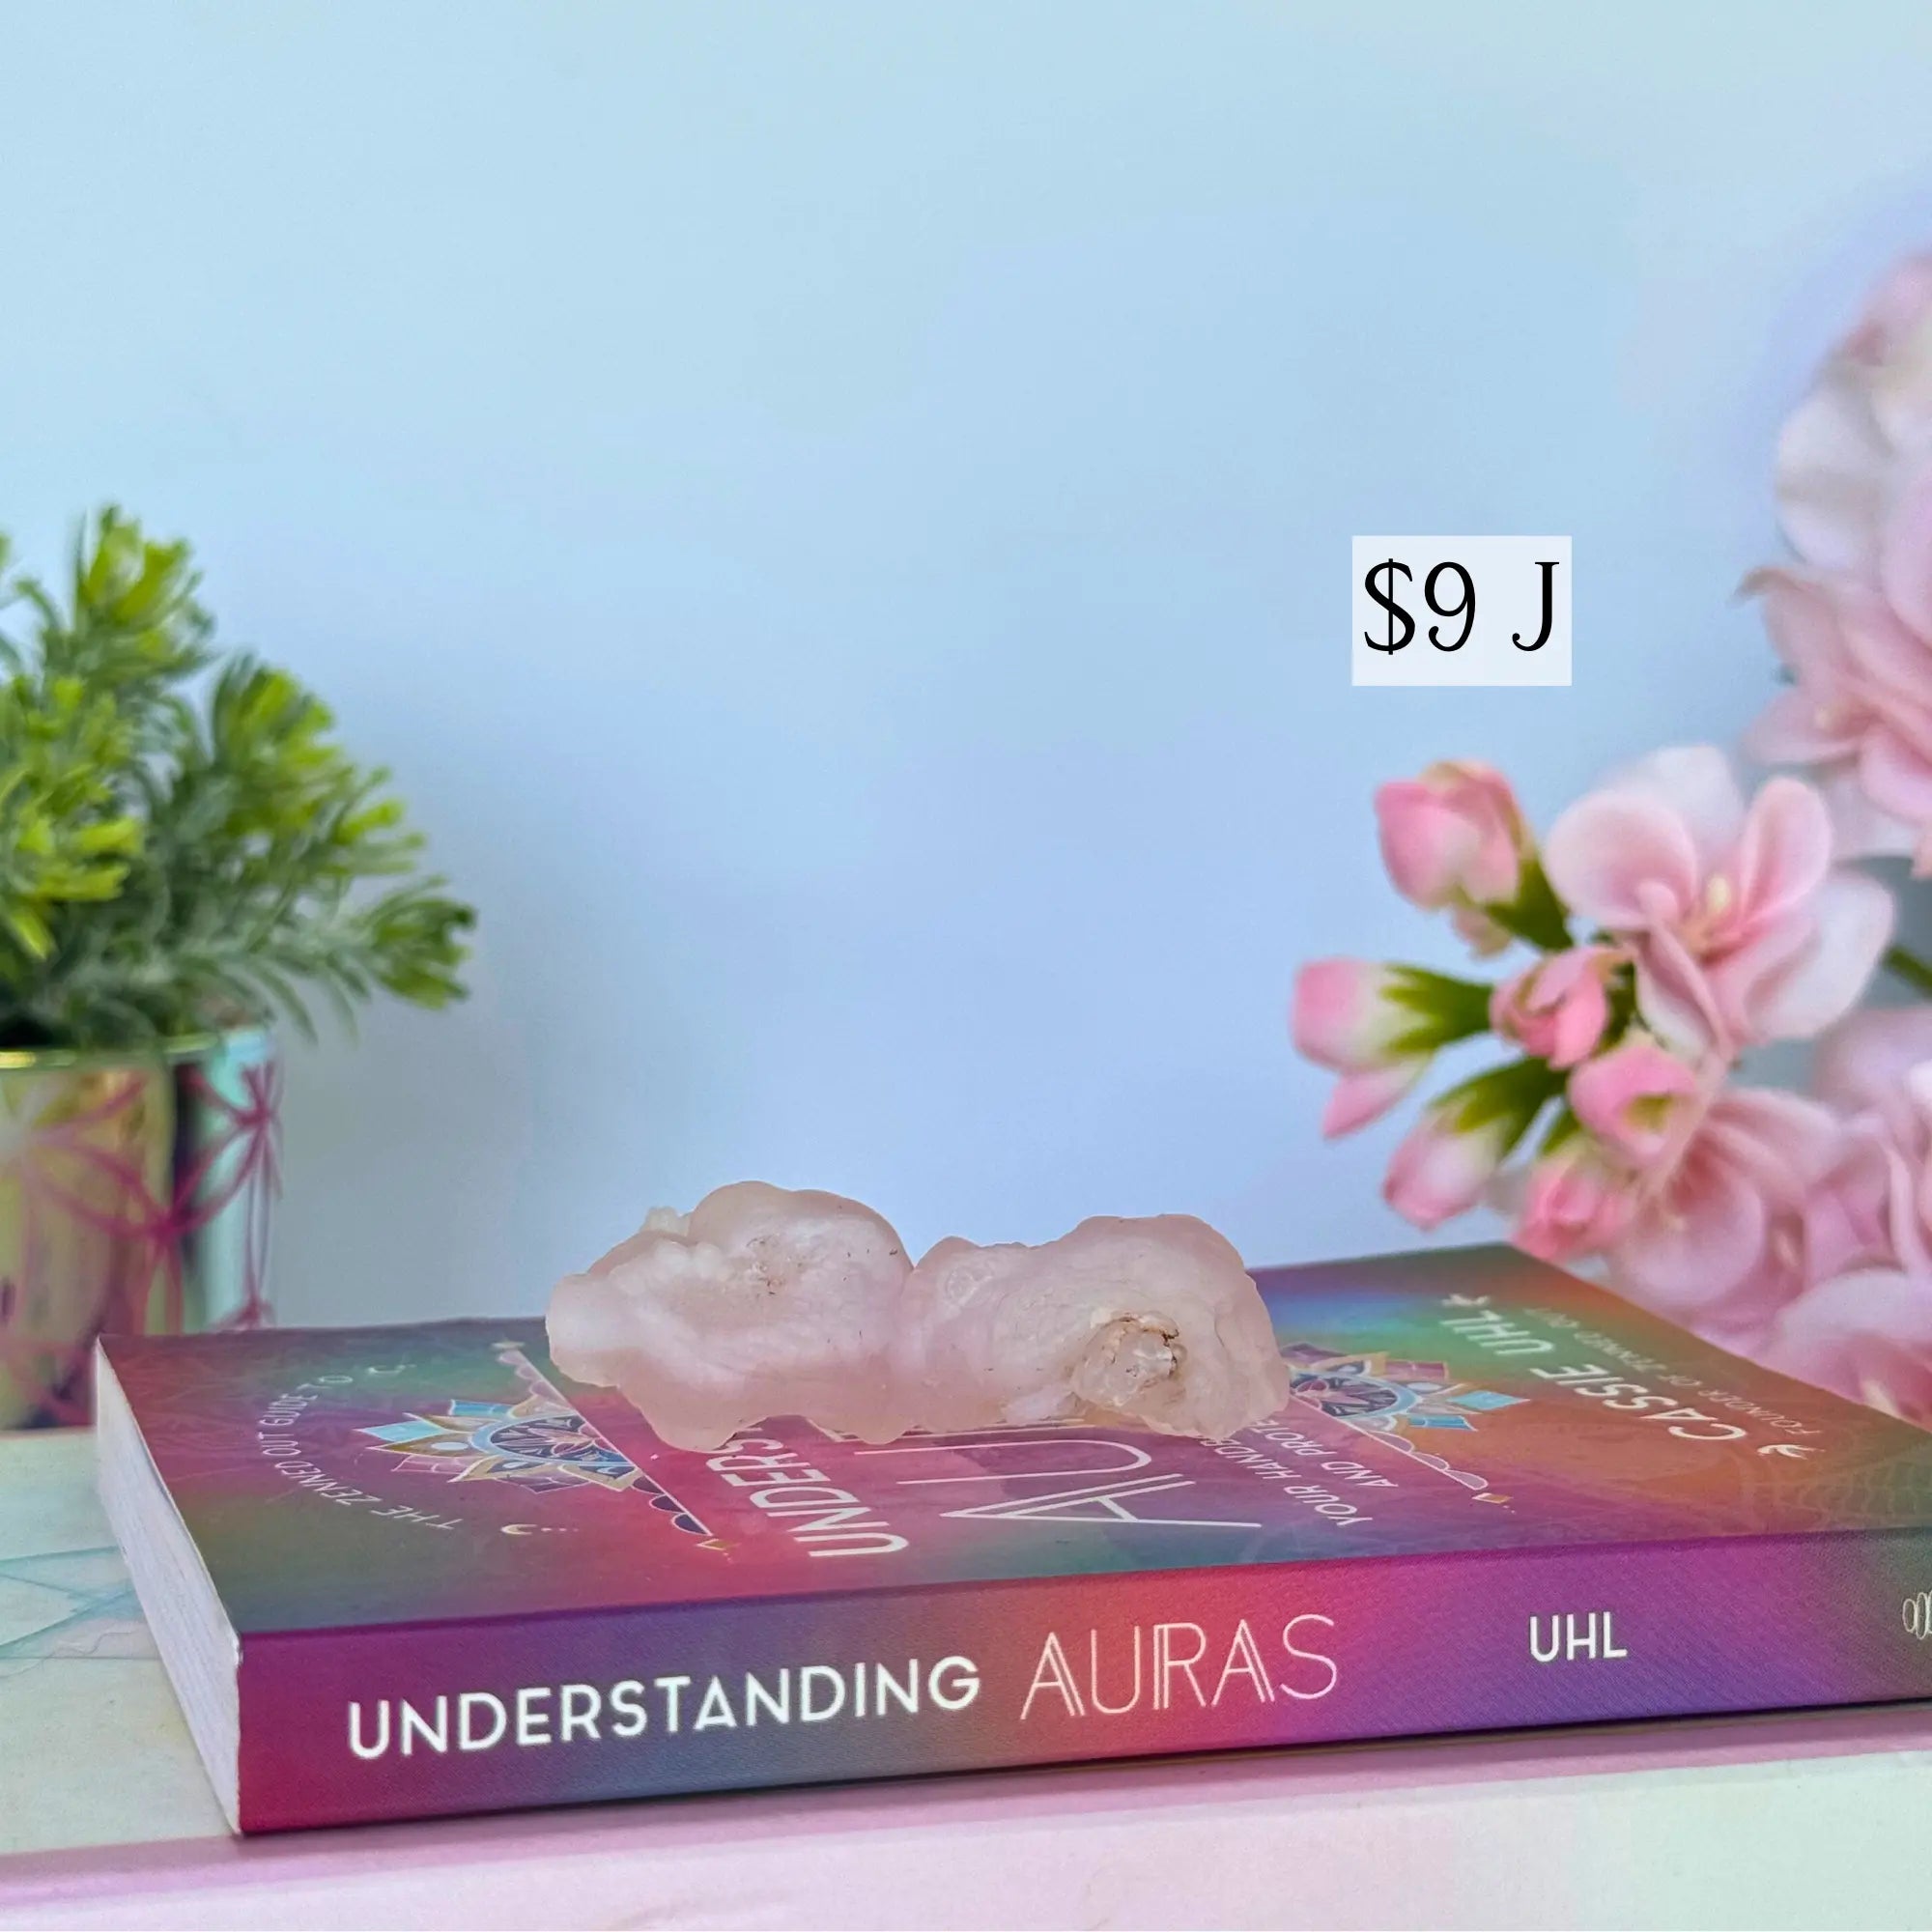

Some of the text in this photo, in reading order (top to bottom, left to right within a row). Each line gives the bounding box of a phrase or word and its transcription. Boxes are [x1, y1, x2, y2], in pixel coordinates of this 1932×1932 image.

[1440, 1310, 1747, 1441] CASSIE UHL
[257, 1392, 319, 1427] GUIDE
[1697, 1388, 1824, 1437] FOUNDER
[257, 1432, 302, 1457] OUT
[274, 1460, 383, 1506] ZENNED
[1320, 1461, 1400, 1488] AND
[369, 1504, 464, 1530] THE
[1283, 1484, 1374, 1527] YOUR
[1528, 1610, 1629, 1664] UHL
[347, 1613, 1340, 1760] UNDERSTANDING AURAS
